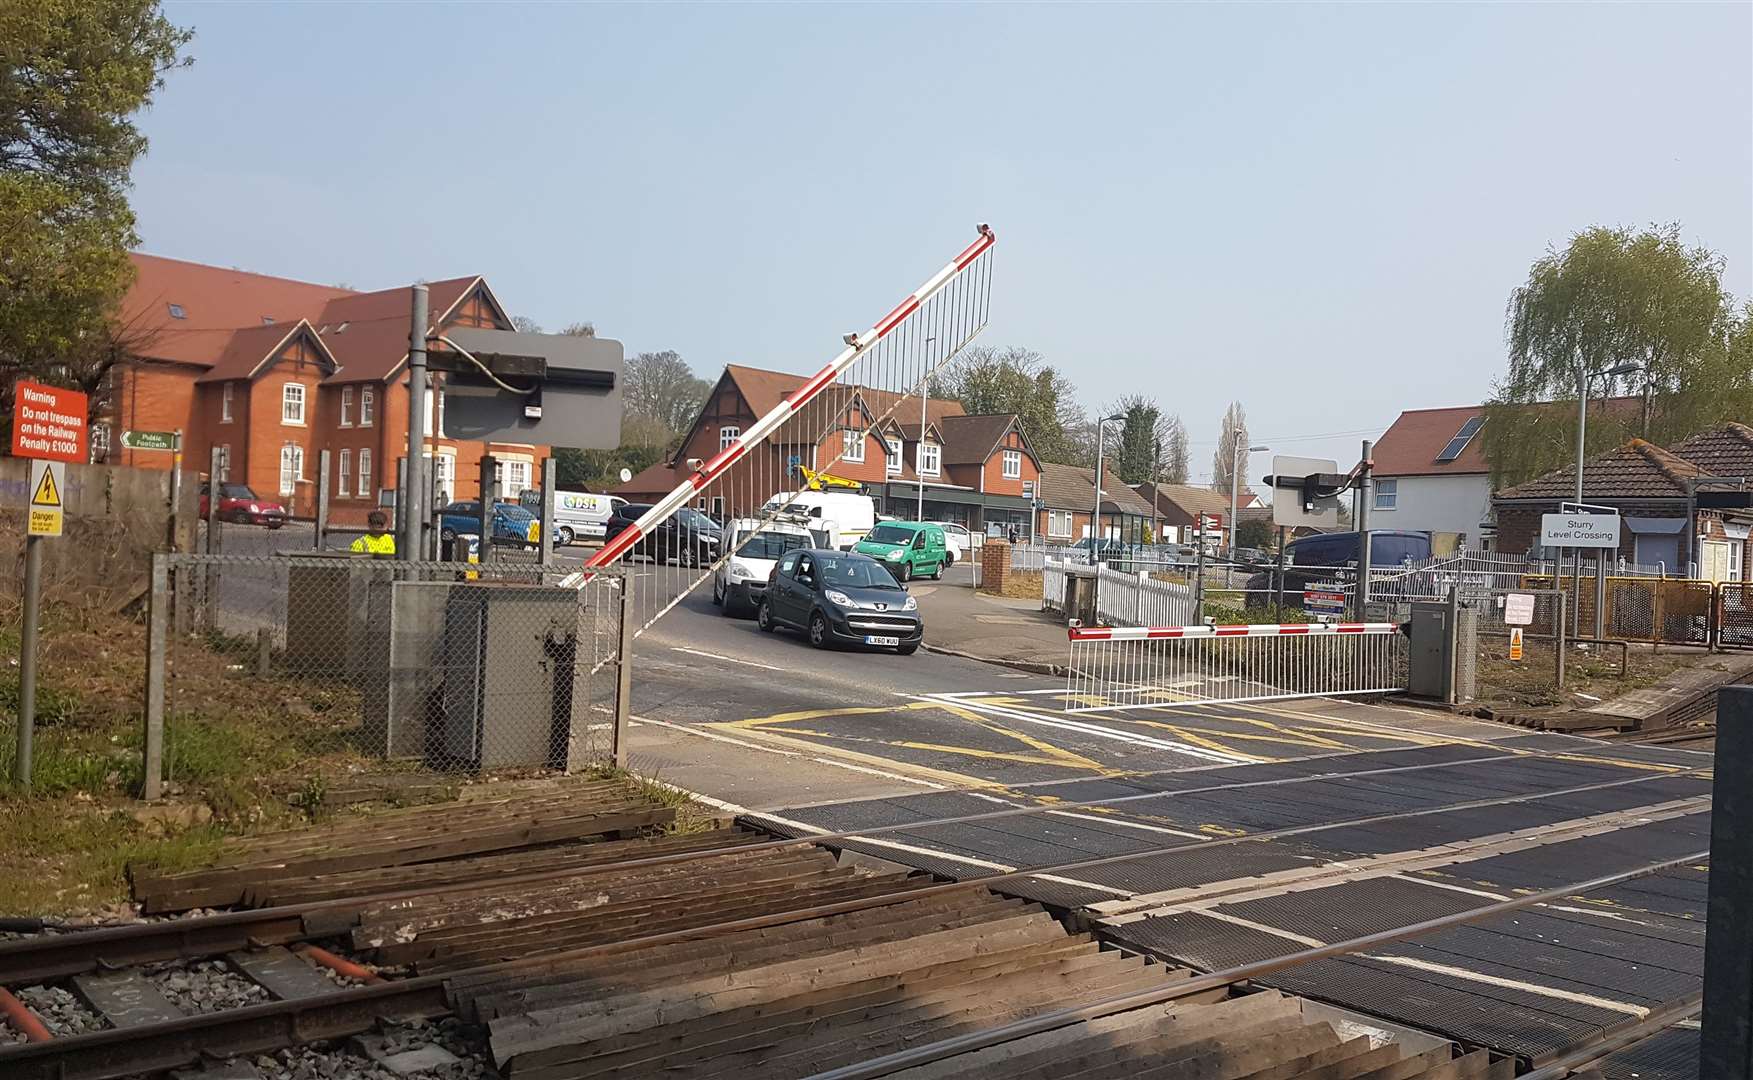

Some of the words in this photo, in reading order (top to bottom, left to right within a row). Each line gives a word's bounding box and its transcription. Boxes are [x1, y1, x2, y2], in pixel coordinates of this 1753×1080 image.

[23, 388, 56, 407] Warning
[22, 406, 34, 418] Do
[35, 410, 48, 421] not
[50, 411, 81, 426] trespass
[21, 423, 32, 433] on
[34, 423, 47, 435] the
[48, 425, 77, 441] Railway
[20, 436, 50, 452] Penalty
[52, 440, 77, 454] £1000
[575, 496, 597, 509] DSL
[32, 511, 54, 521] Danger
[1567, 520, 1594, 530] Sturry
[1548, 530, 1571, 538] Level
[1573, 531, 1613, 540] Crossing
